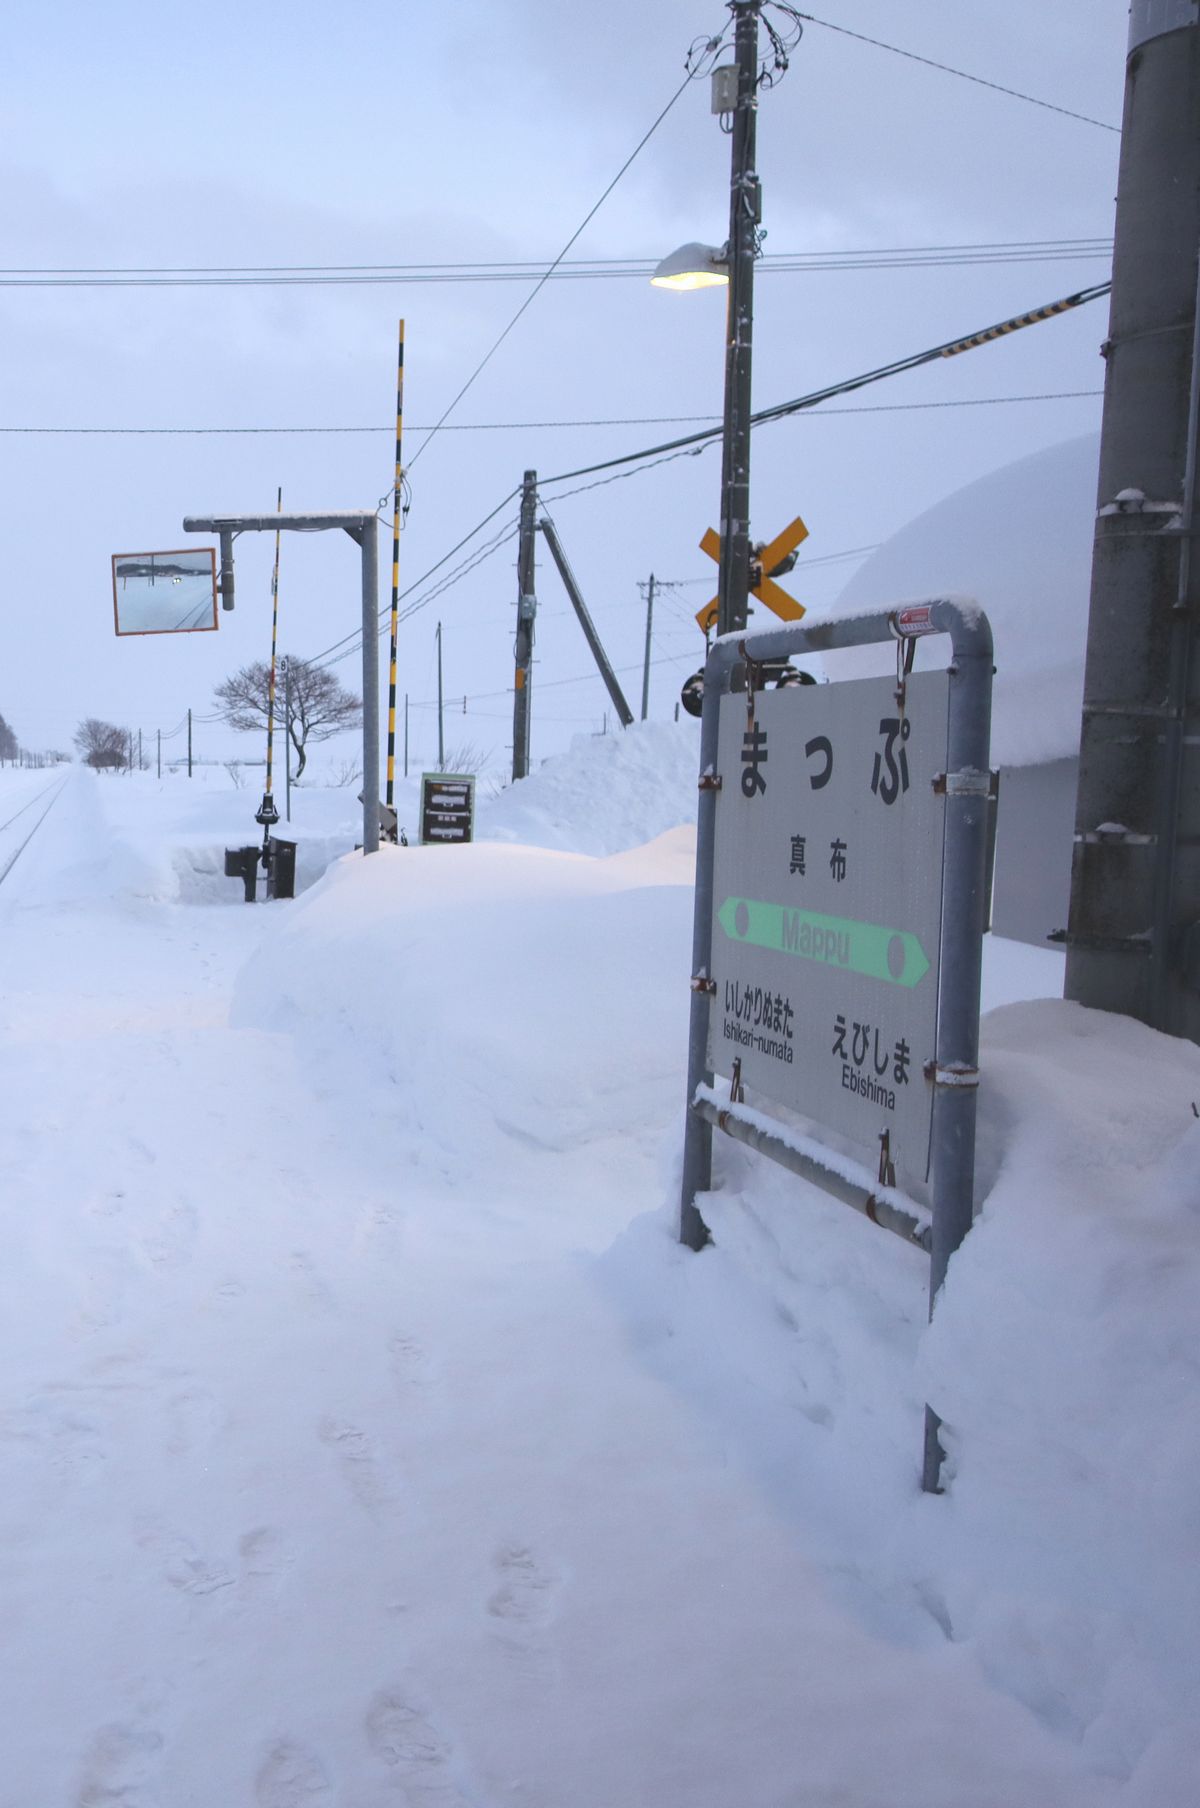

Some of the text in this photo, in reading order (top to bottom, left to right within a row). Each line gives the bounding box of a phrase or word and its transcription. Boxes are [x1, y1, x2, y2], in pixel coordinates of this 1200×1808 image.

[789, 834, 847, 883] 真布
[782, 909, 850, 965] Mappu
[725, 980, 794, 1038] いしかりぬまた
[723, 1018, 793, 1063] Ishikari-numata
[831, 1014, 910, 1085] えびしま
[842, 1063, 895, 1110] Ebishima
